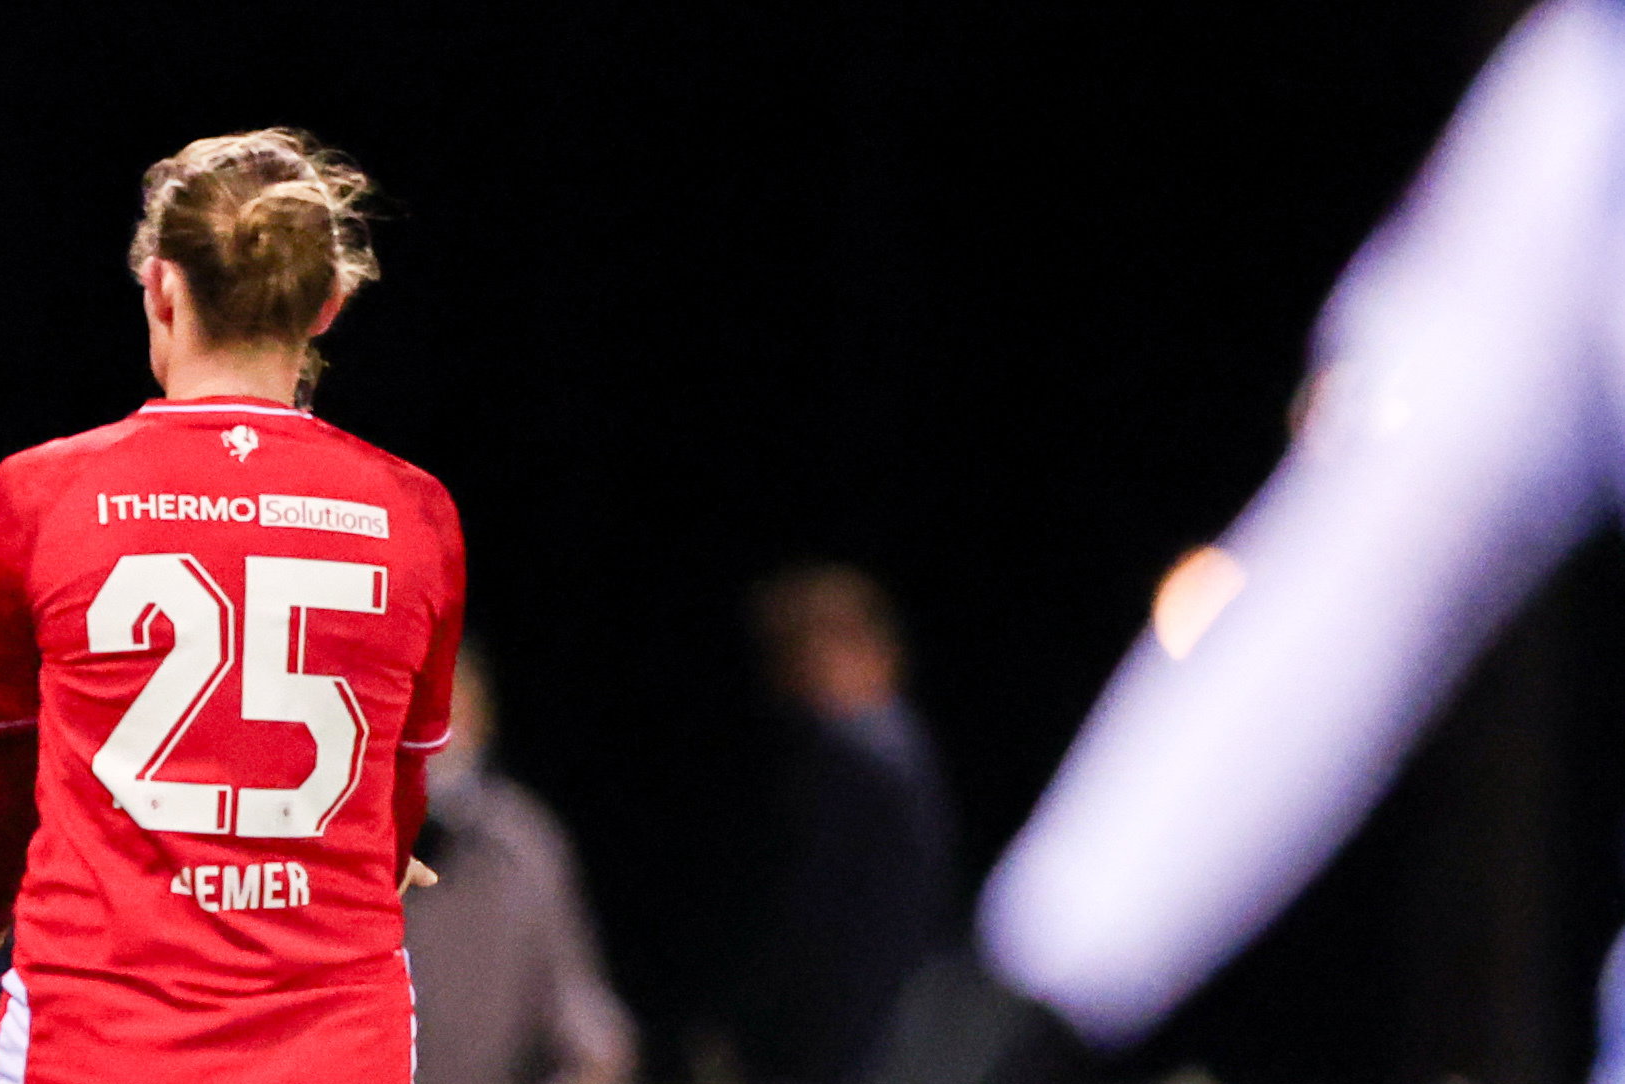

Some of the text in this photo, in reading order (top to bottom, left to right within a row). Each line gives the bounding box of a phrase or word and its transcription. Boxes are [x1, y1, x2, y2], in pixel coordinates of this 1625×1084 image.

[110, 494, 384, 535] THERMO Solutions
[86, 553, 388, 837] 25
